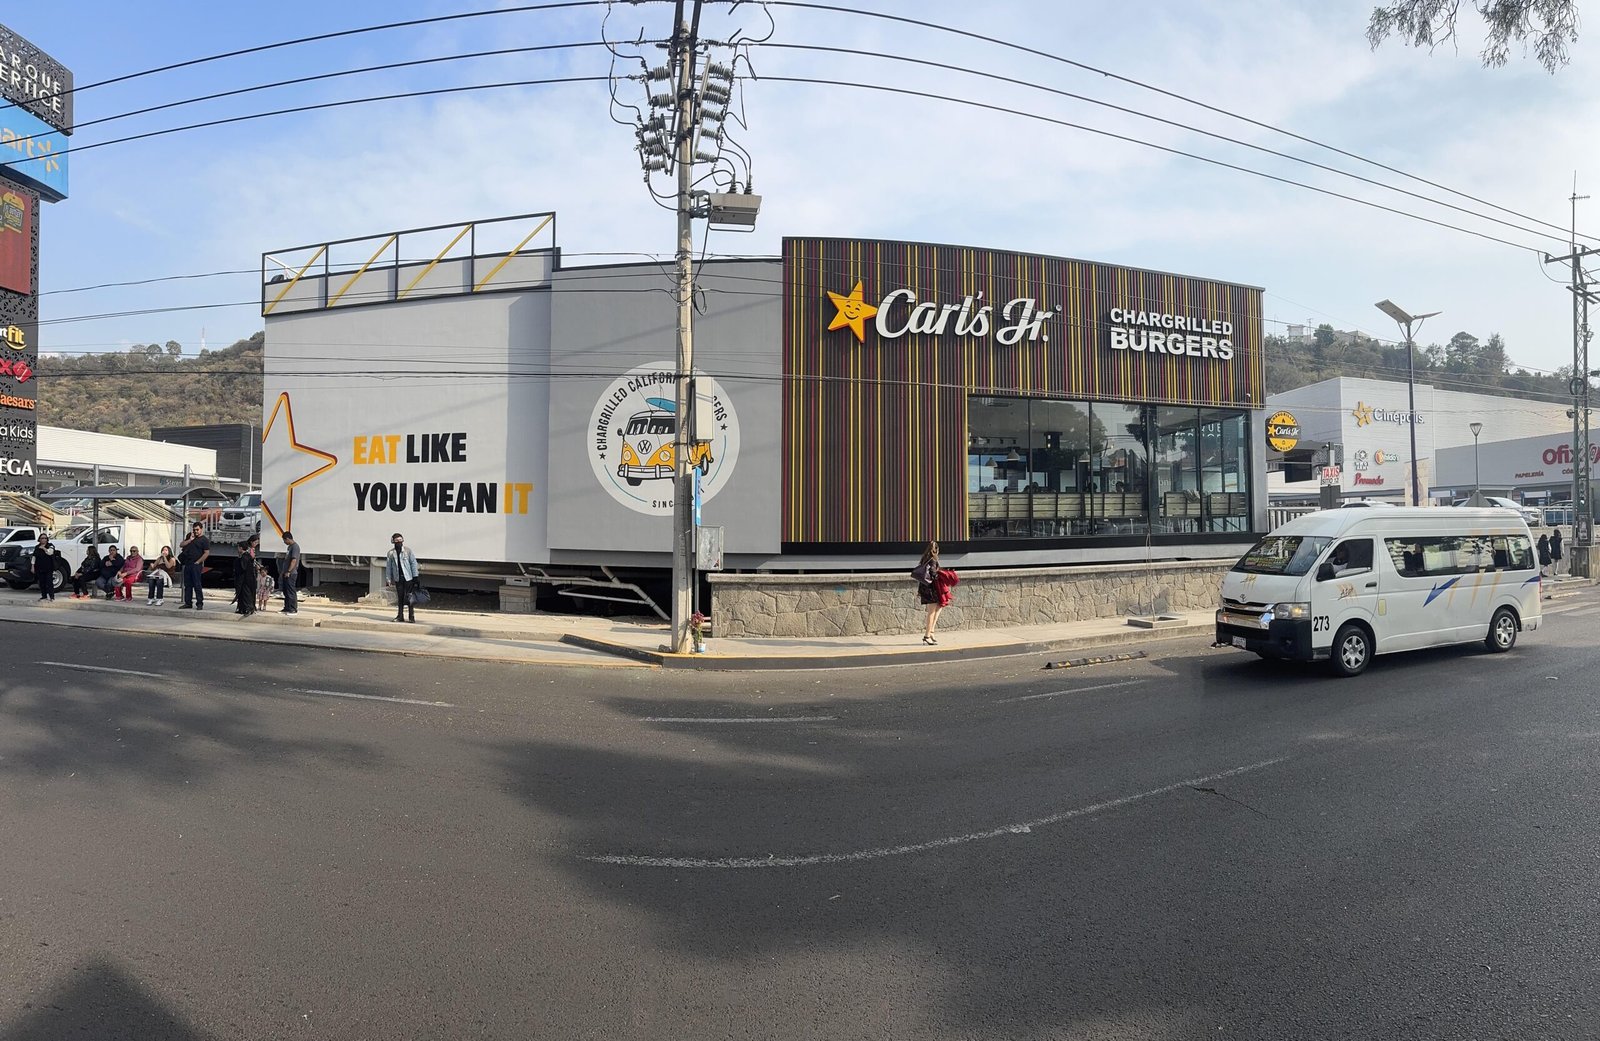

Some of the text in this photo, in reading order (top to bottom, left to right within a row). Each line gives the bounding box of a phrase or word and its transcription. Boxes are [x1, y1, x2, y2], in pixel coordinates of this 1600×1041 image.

[0, 127, 35, 159] art
[875, 288, 993, 339] Carl's
[1109, 307, 1233, 336] CHARGRILLED
[1110, 328, 1234, 361] BURGERS
[597, 386, 628, 451] CHARGRILLED
[627, 371, 677, 392] CALIFOR
[9, 425, 34, 439] Kids
[353, 432, 467, 465] EAT LIKE
[1322, 467, 1340, 479] TAXIS
[353, 482, 534, 515] YOU MEAN IT
[652, 500, 675, 508] SINC
[1313, 616, 1330, 632] 273
